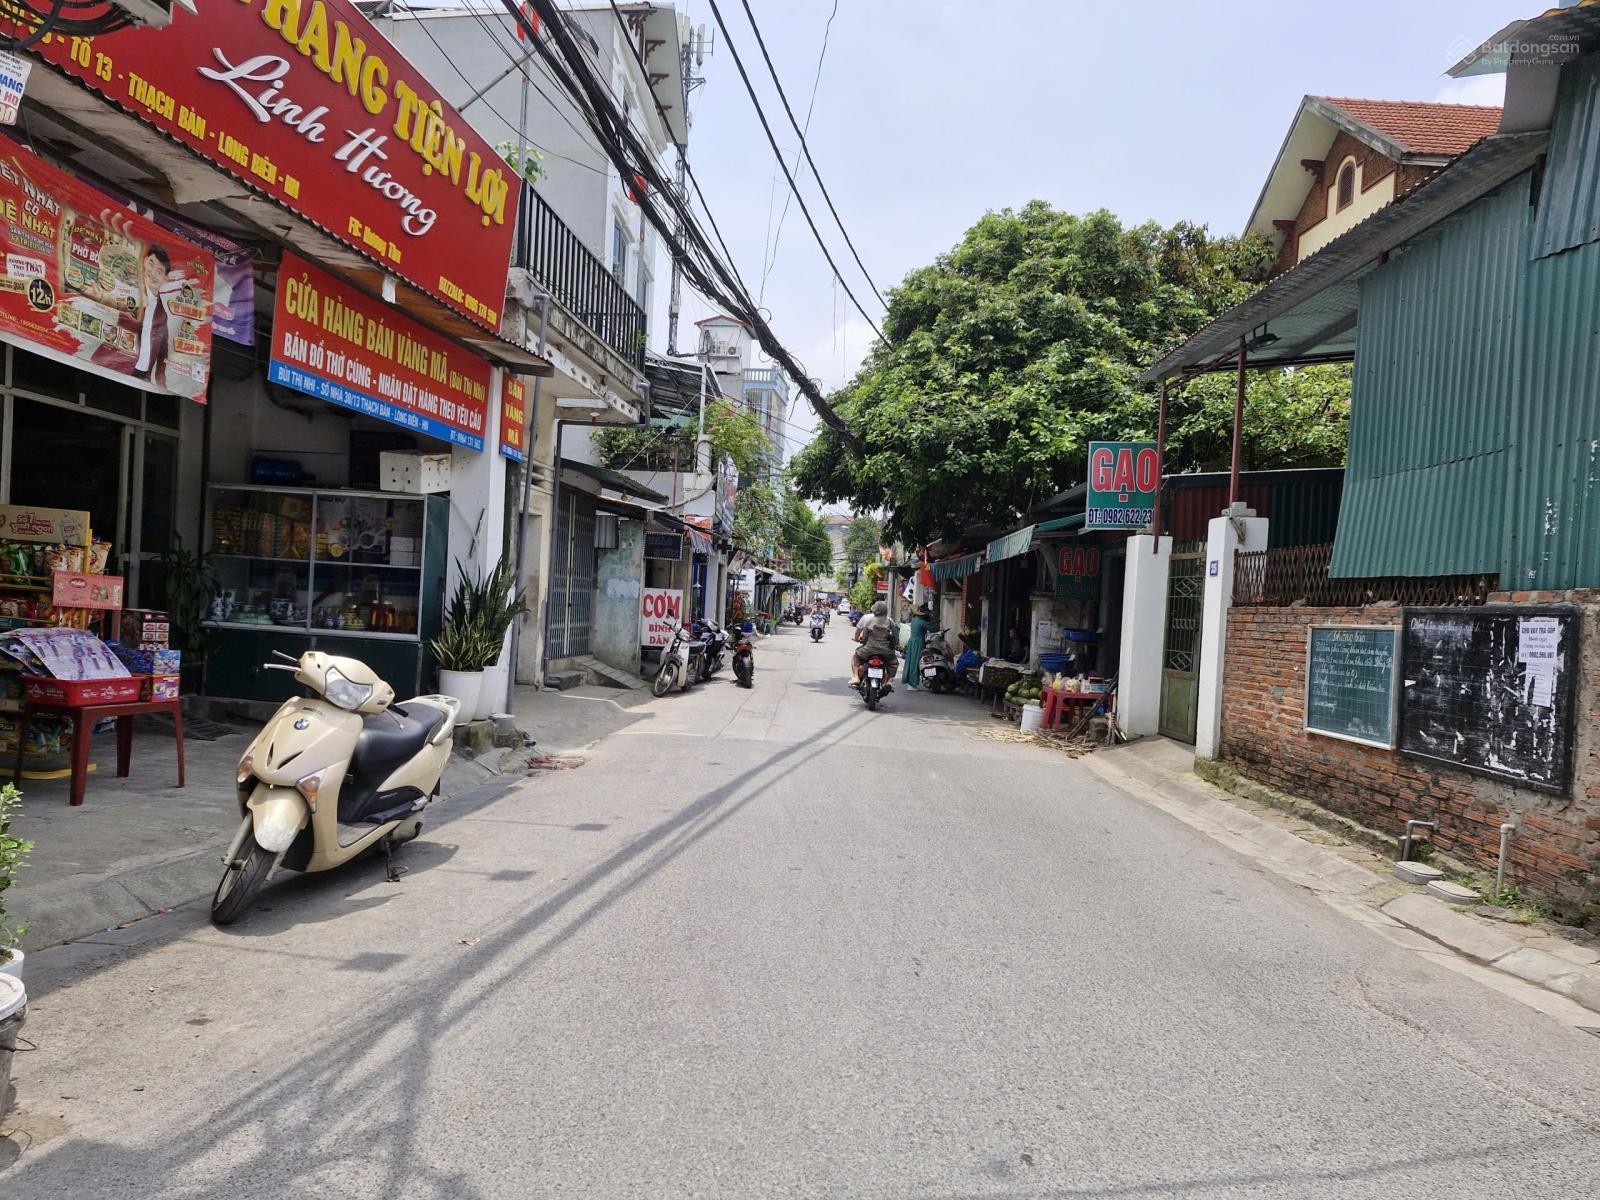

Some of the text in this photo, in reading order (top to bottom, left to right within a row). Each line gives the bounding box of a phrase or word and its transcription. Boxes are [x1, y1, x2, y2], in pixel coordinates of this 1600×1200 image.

[71, 35, 94, 68] TỔ
[96, 52, 112, 81] 13
[128, 72, 175, 122] THẠCH
[178, 105, 206, 140] BÀN
[218, 131, 249, 167] LONG
[251, 152, 277, 185] BIÊN
[197, 48, 330, 143] Linh
[393, 80, 466, 185] TIỆN
[465, 152, 508, 226] LỢI
[22, 176, 61, 217] NHẤT
[24, 199, 40, 216] CÓ
[21, 211, 56, 239] NHẤT
[72, 243, 89, 259] PHỞ
[30, 285, 51, 305] 12h
[285, 272, 319, 326] CỬA
[322, 296, 364, 346] HÀNG
[366, 318, 394, 360] BÁN
[397, 332, 428, 375] VÀNG
[430, 351, 448, 384] MÃ
[278, 365, 291, 382] BÙI
[291, 371, 302, 390] THỊ
[321, 381, 330, 396] SỐ
[330, 387, 343, 402] NHÀ
[361, 398, 379, 414] THẠCH
[380, 401, 391, 418] BÀN
[394, 409, 407, 423] LONG
[284, 331, 307, 363] BÁN
[326, 350, 345, 378] THỜ
[346, 358, 371, 388] CÚNG
[378, 372, 401, 402] NHẬN
[403, 382, 418, 409] ĐẶT
[418, 387, 438, 414] HÀNG
[439, 398, 456, 421] THEO
[457, 404, 469, 426] YÊU
[508, 381, 523, 401] BÁN
[506, 402, 524, 425] VÀNG
[1091, 447, 1159, 503] GẠO
[1088, 507, 1101, 525] ĐT:
[1103, 507, 1124, 525] 0982
[1125, 508, 1141, 525] 622
[1059, 546, 1099, 583] GẠO
[642, 590, 681, 620] CƠM
[649, 634, 670, 645] DÂN
